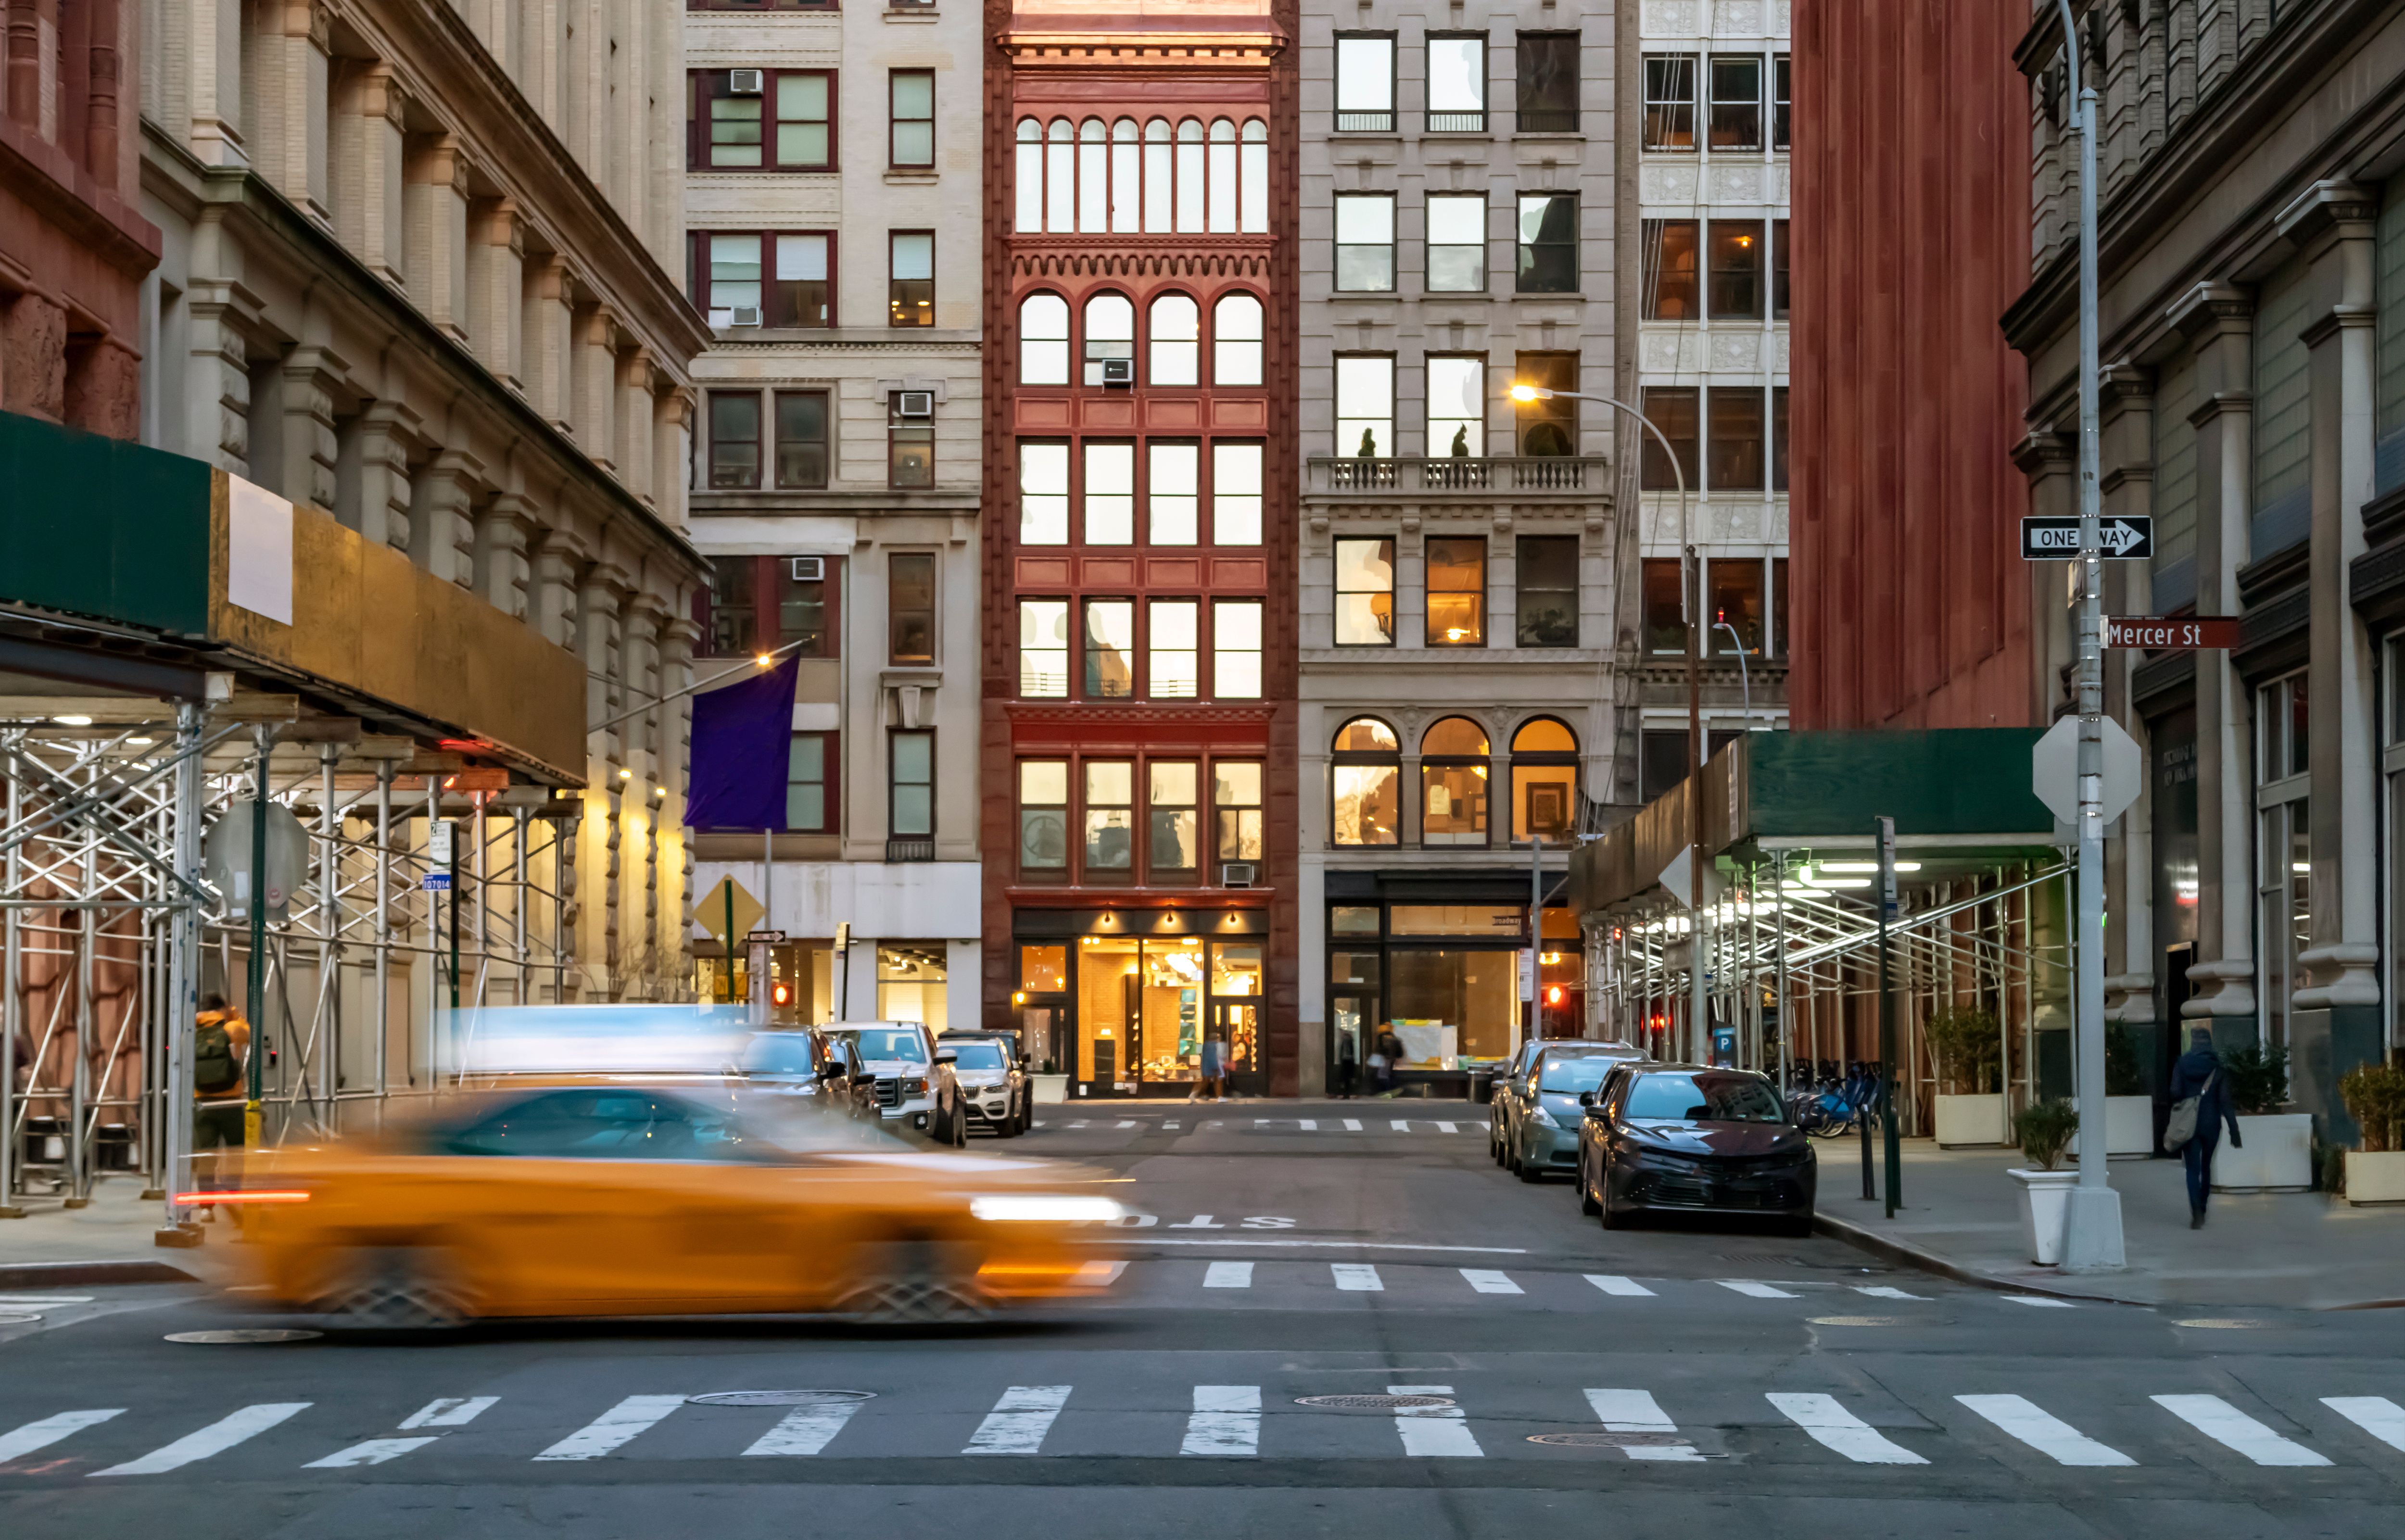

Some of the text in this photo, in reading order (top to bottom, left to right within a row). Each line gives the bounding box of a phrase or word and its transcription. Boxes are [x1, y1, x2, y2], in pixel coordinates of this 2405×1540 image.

[2041, 530, 2077, 546] ONE
[2109, 624, 2201, 645] Mercer St
[424, 880, 450, 889] 107014
[1721, 1037, 1729, 1049] P
[1105, 1214, 1297, 1229] STO
